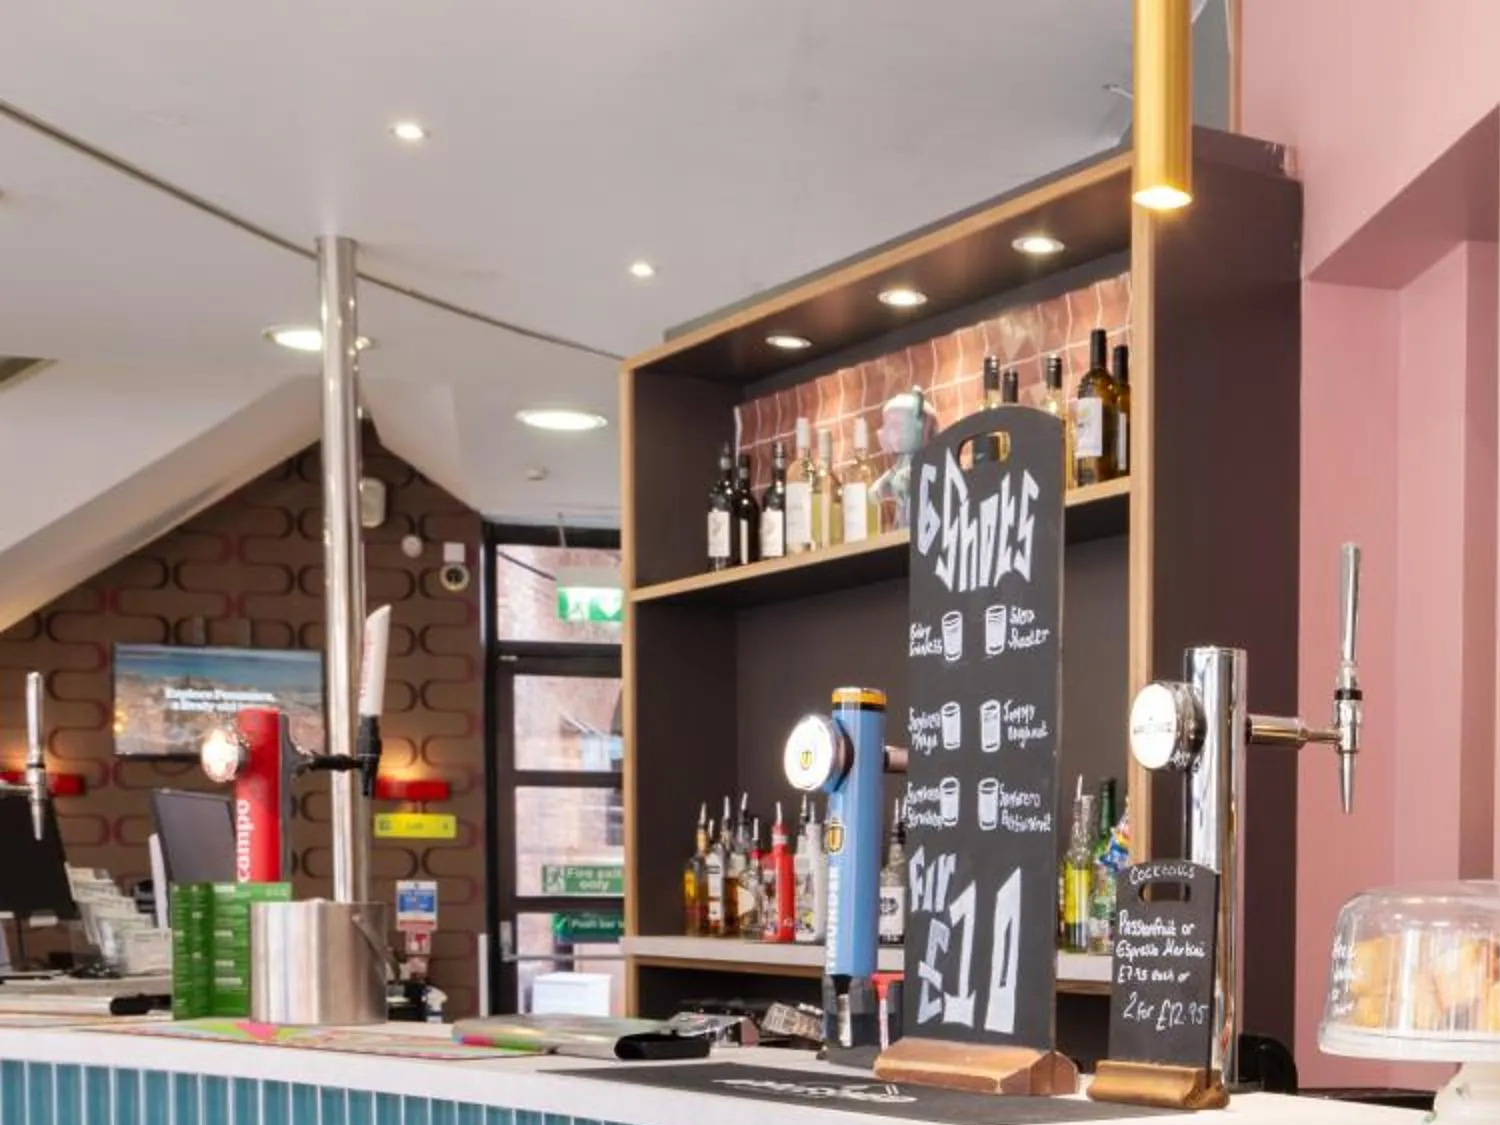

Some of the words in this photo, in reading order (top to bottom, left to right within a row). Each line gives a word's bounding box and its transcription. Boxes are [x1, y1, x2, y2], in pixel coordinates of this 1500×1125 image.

[917, 463, 941, 556] 6
[236, 799, 256, 883] campo
[917, 867, 1021, 1034] £10
[1181, 923, 1196, 936] or
[1123, 991, 1137, 1019] 2
